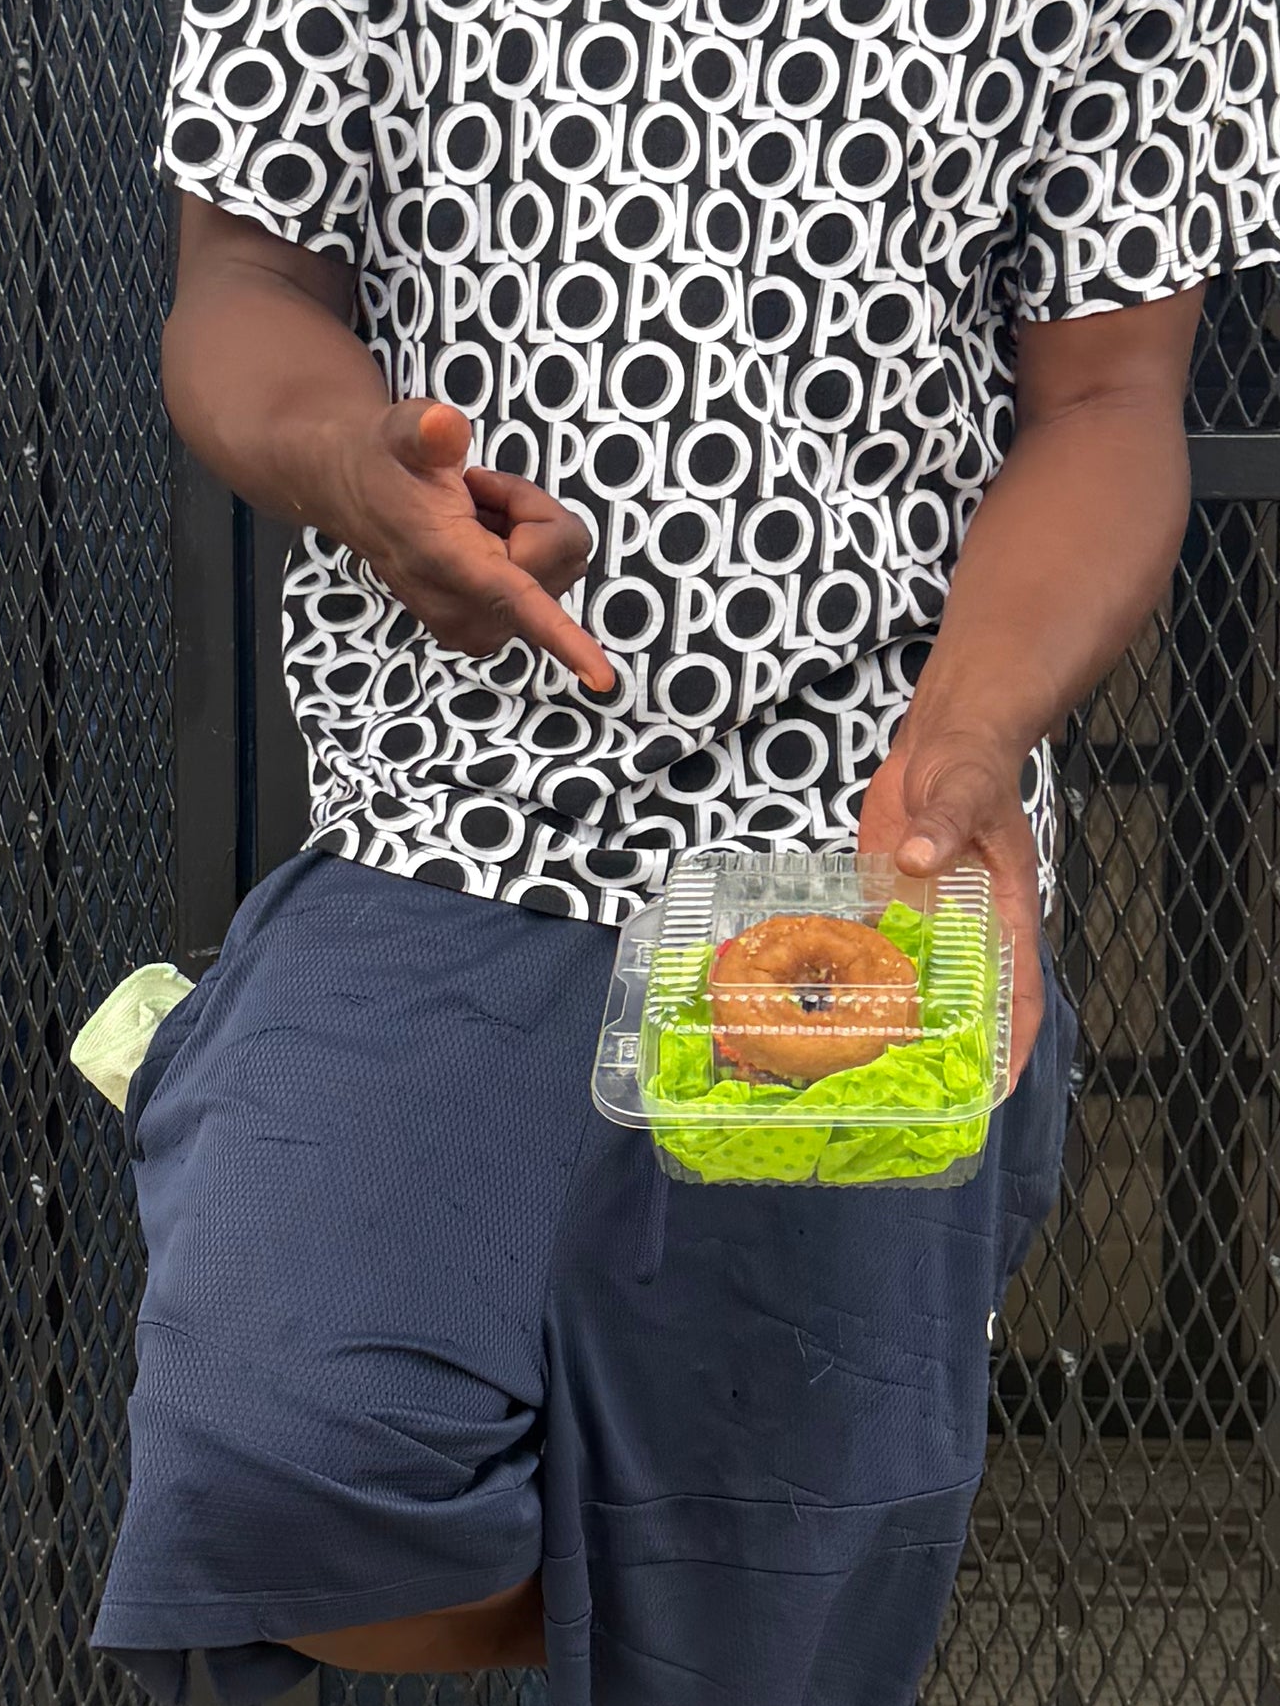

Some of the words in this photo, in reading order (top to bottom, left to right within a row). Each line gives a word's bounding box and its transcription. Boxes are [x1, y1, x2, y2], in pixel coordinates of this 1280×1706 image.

[448, 12, 639, 105] POLO
[644, 21, 840, 121] POLO
[843, 38, 1024, 139] POLO
[509, 98, 701, 185] POLO
[705, 113, 903, 202] POLO
[1035, 132, 1185, 231] OLO
[559, 182, 749, 267] POLO
[1064, 192, 1221, 304] POLO
[440, 261, 619, 344] POLO
[624, 262, 807, 355] POLO
[498, 341, 685, 422] POLO
[690, 341, 864, 433] POLO
[545, 419, 752, 501] POLO
[758, 423, 910, 505] POLO
[605, 496, 815, 578] POLO
[819, 488, 949, 572] POLO
[671, 569, 871, 654] POLO
